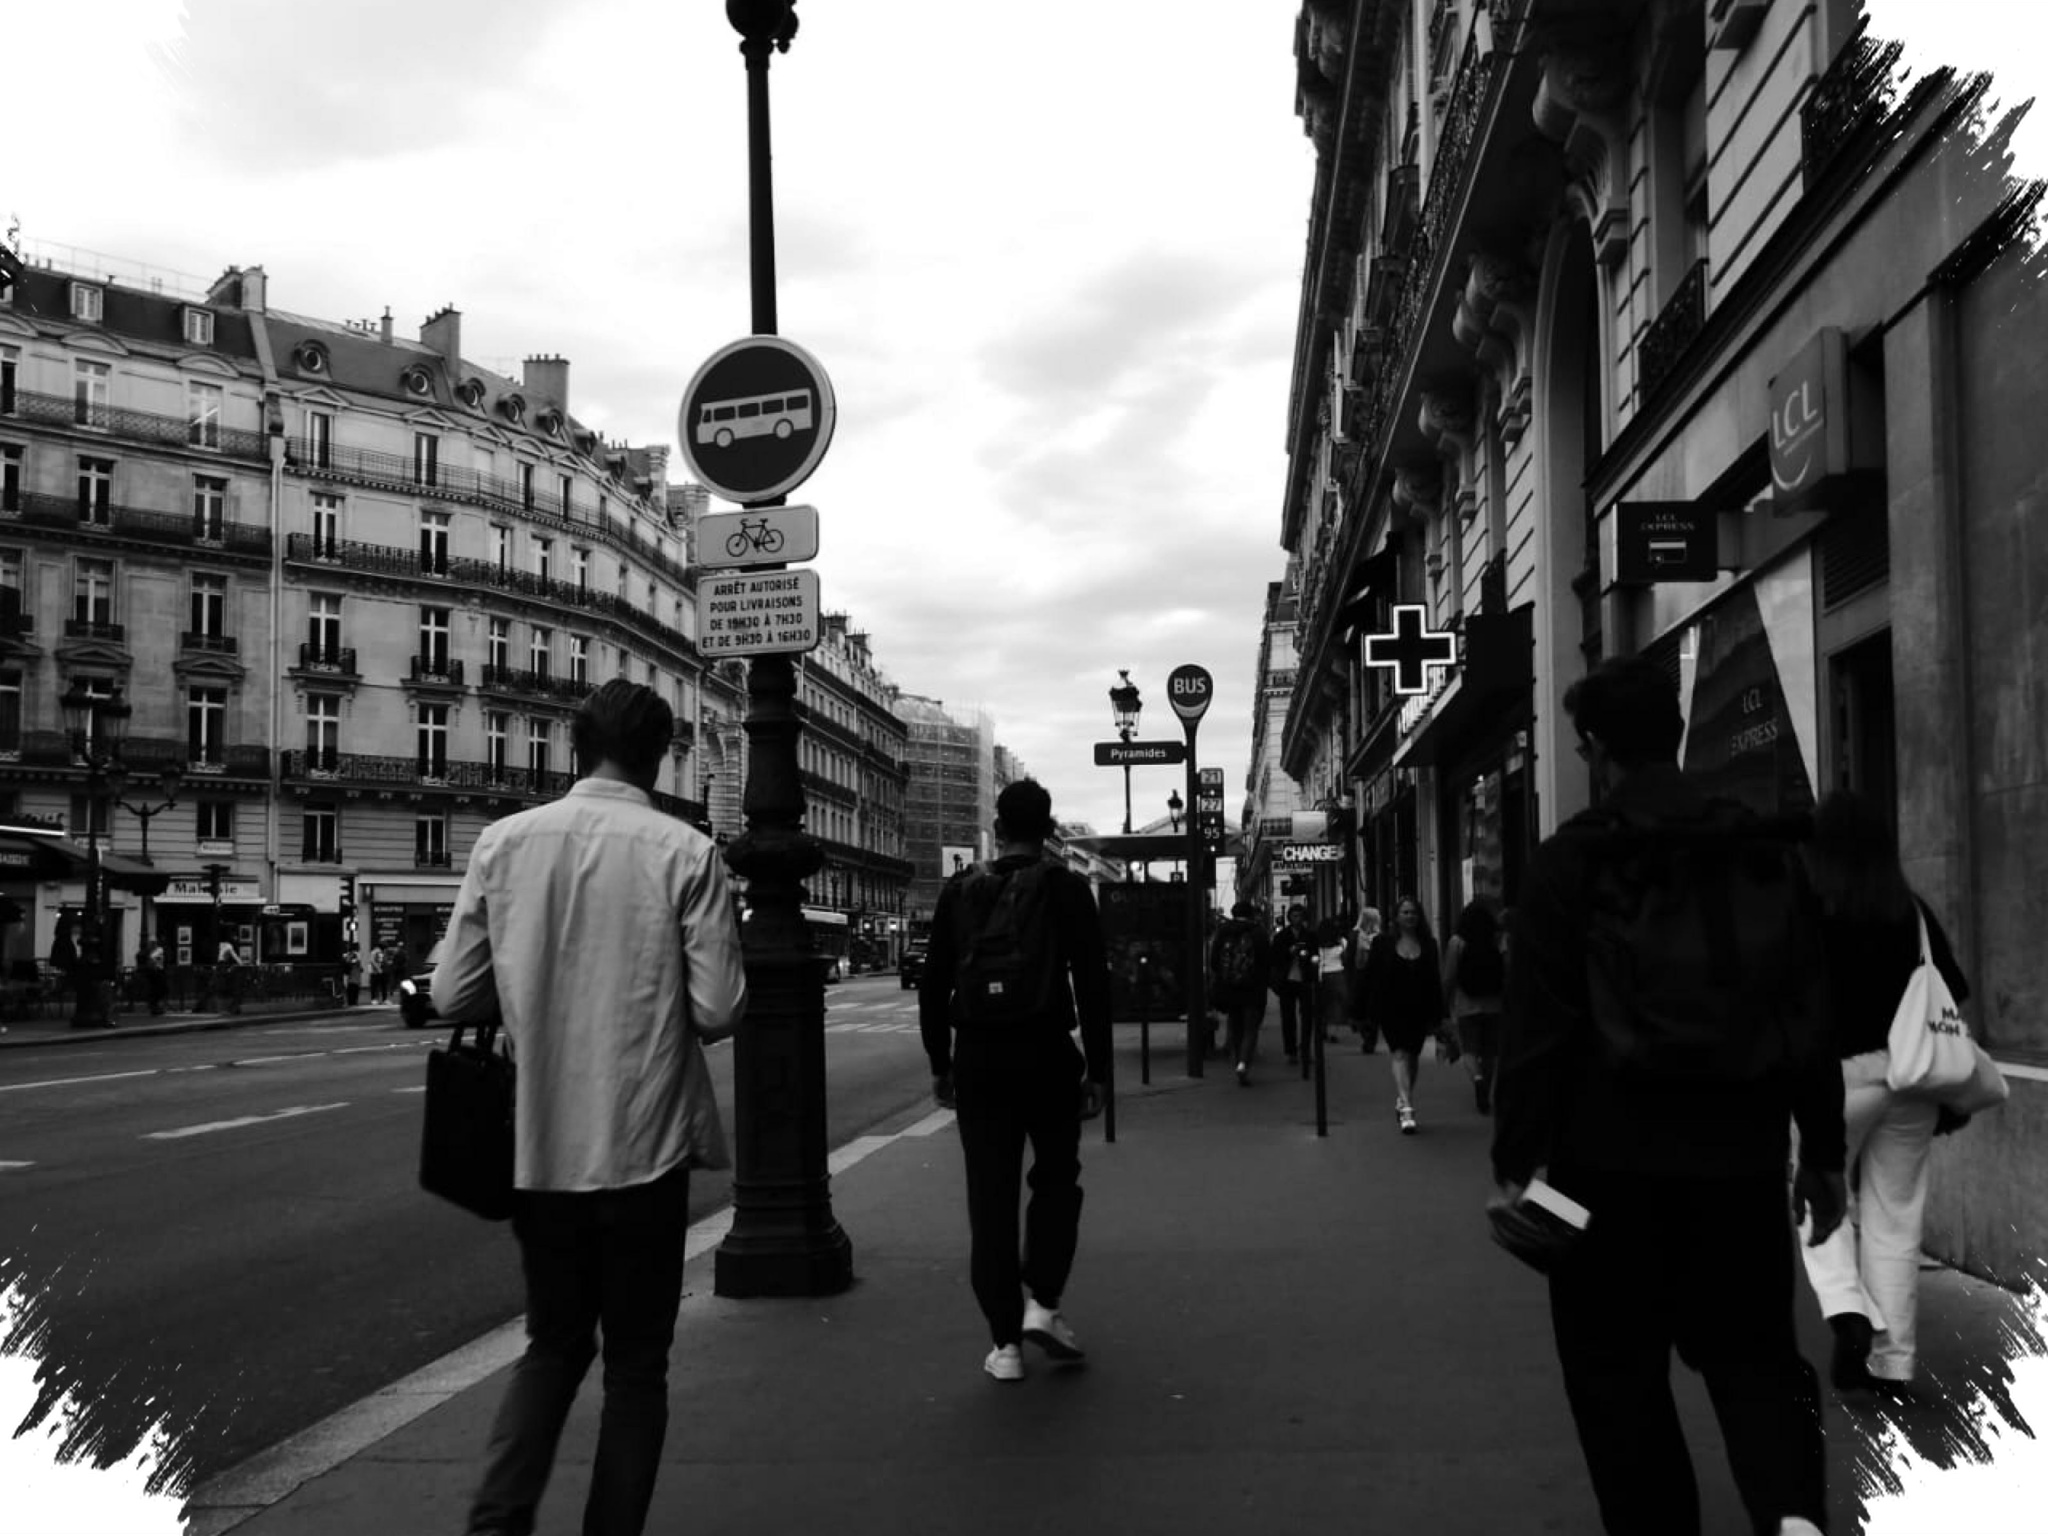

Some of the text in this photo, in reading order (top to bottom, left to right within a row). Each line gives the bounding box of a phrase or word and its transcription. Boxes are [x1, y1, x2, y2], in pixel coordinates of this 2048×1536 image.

[1773, 379, 1818, 449] LCL
[1640, 521, 1696, 531] EXPRESS
[714, 576, 799, 596] ARRÊT AUTORISÉ
[709, 595, 803, 613] POUR LIVRAISONS
[710, 618, 723, 631] DE
[775, 612, 803, 626] 7H30
[702, 636, 715, 649] ET
[718, 634, 731, 647] DE
[735, 632, 763, 646] 9H30
[777, 627, 811, 643] 16H30
[1174, 675, 1206, 695] BUS
[1110, 748, 1167, 761] Pyramides
[1204, 799, 1219, 811] 27
[1204, 827, 1220, 840] 95
[1284, 844, 1338, 862] CHANGE
